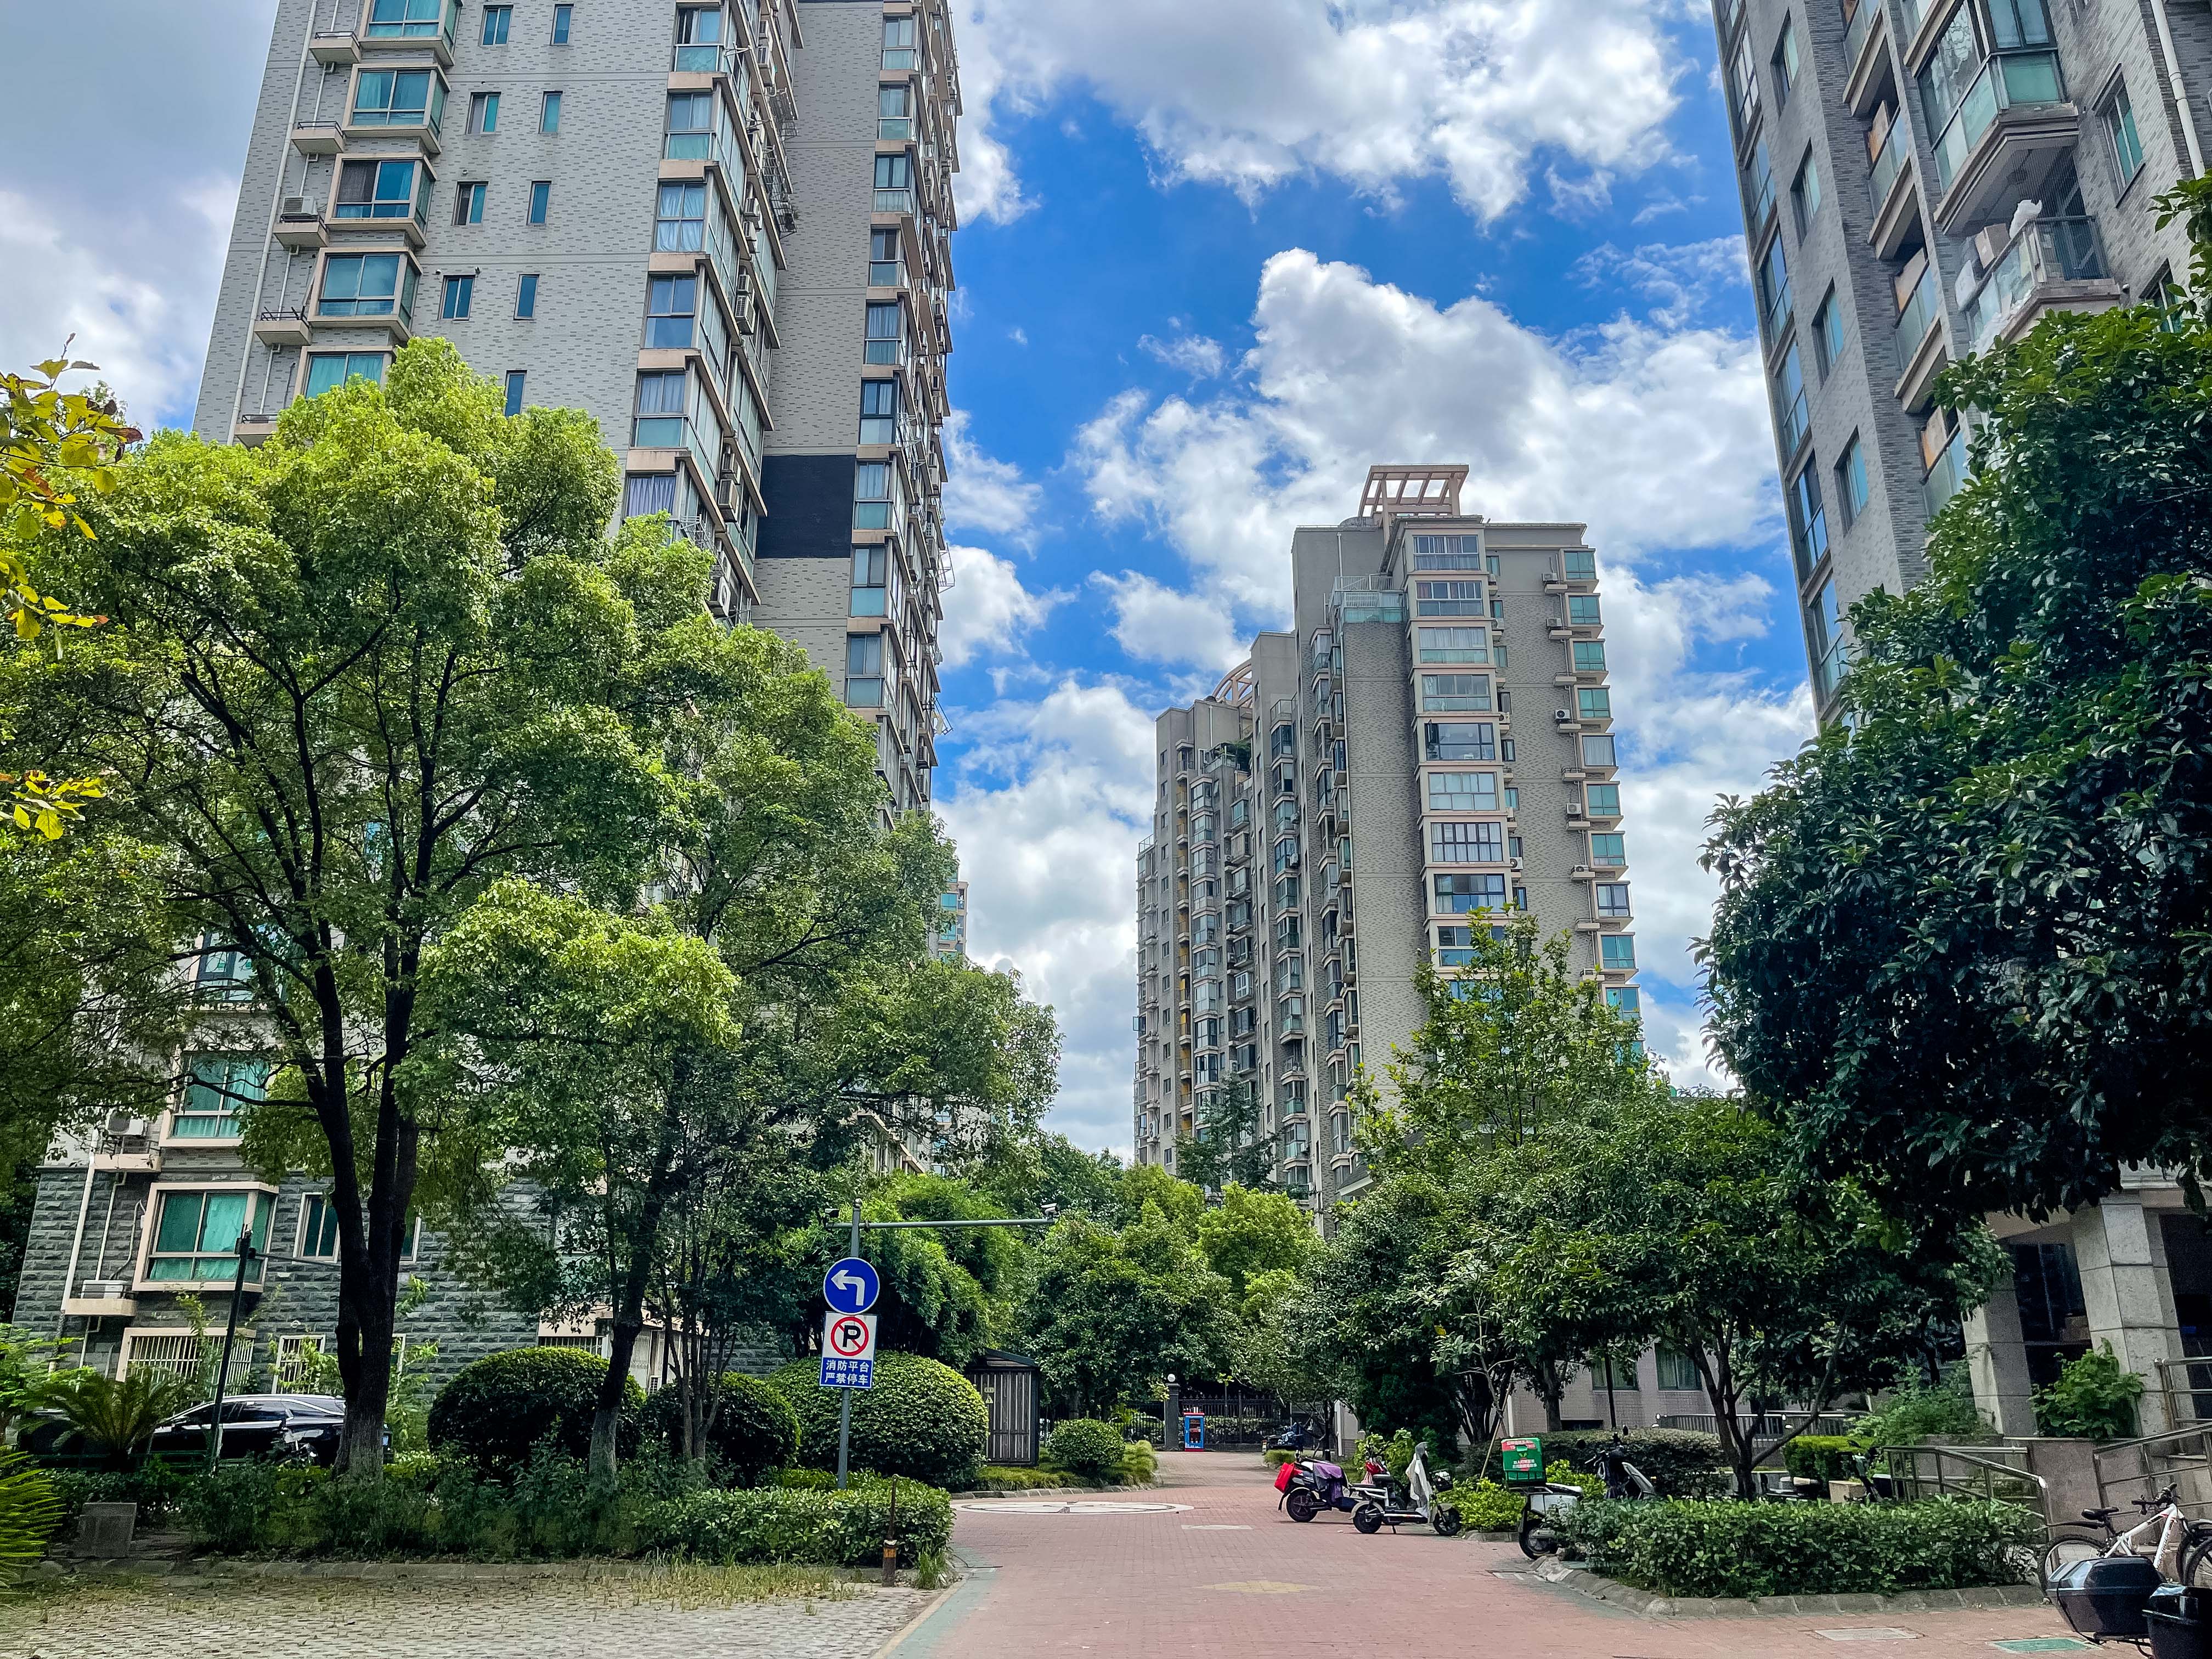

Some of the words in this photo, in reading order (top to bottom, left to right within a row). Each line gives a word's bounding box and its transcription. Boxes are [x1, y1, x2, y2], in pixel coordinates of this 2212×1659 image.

[842, 1324, 861, 1348] P
[826, 1359, 870, 1373] 消防平台
[824, 1372, 868, 1385] 严禁停车
